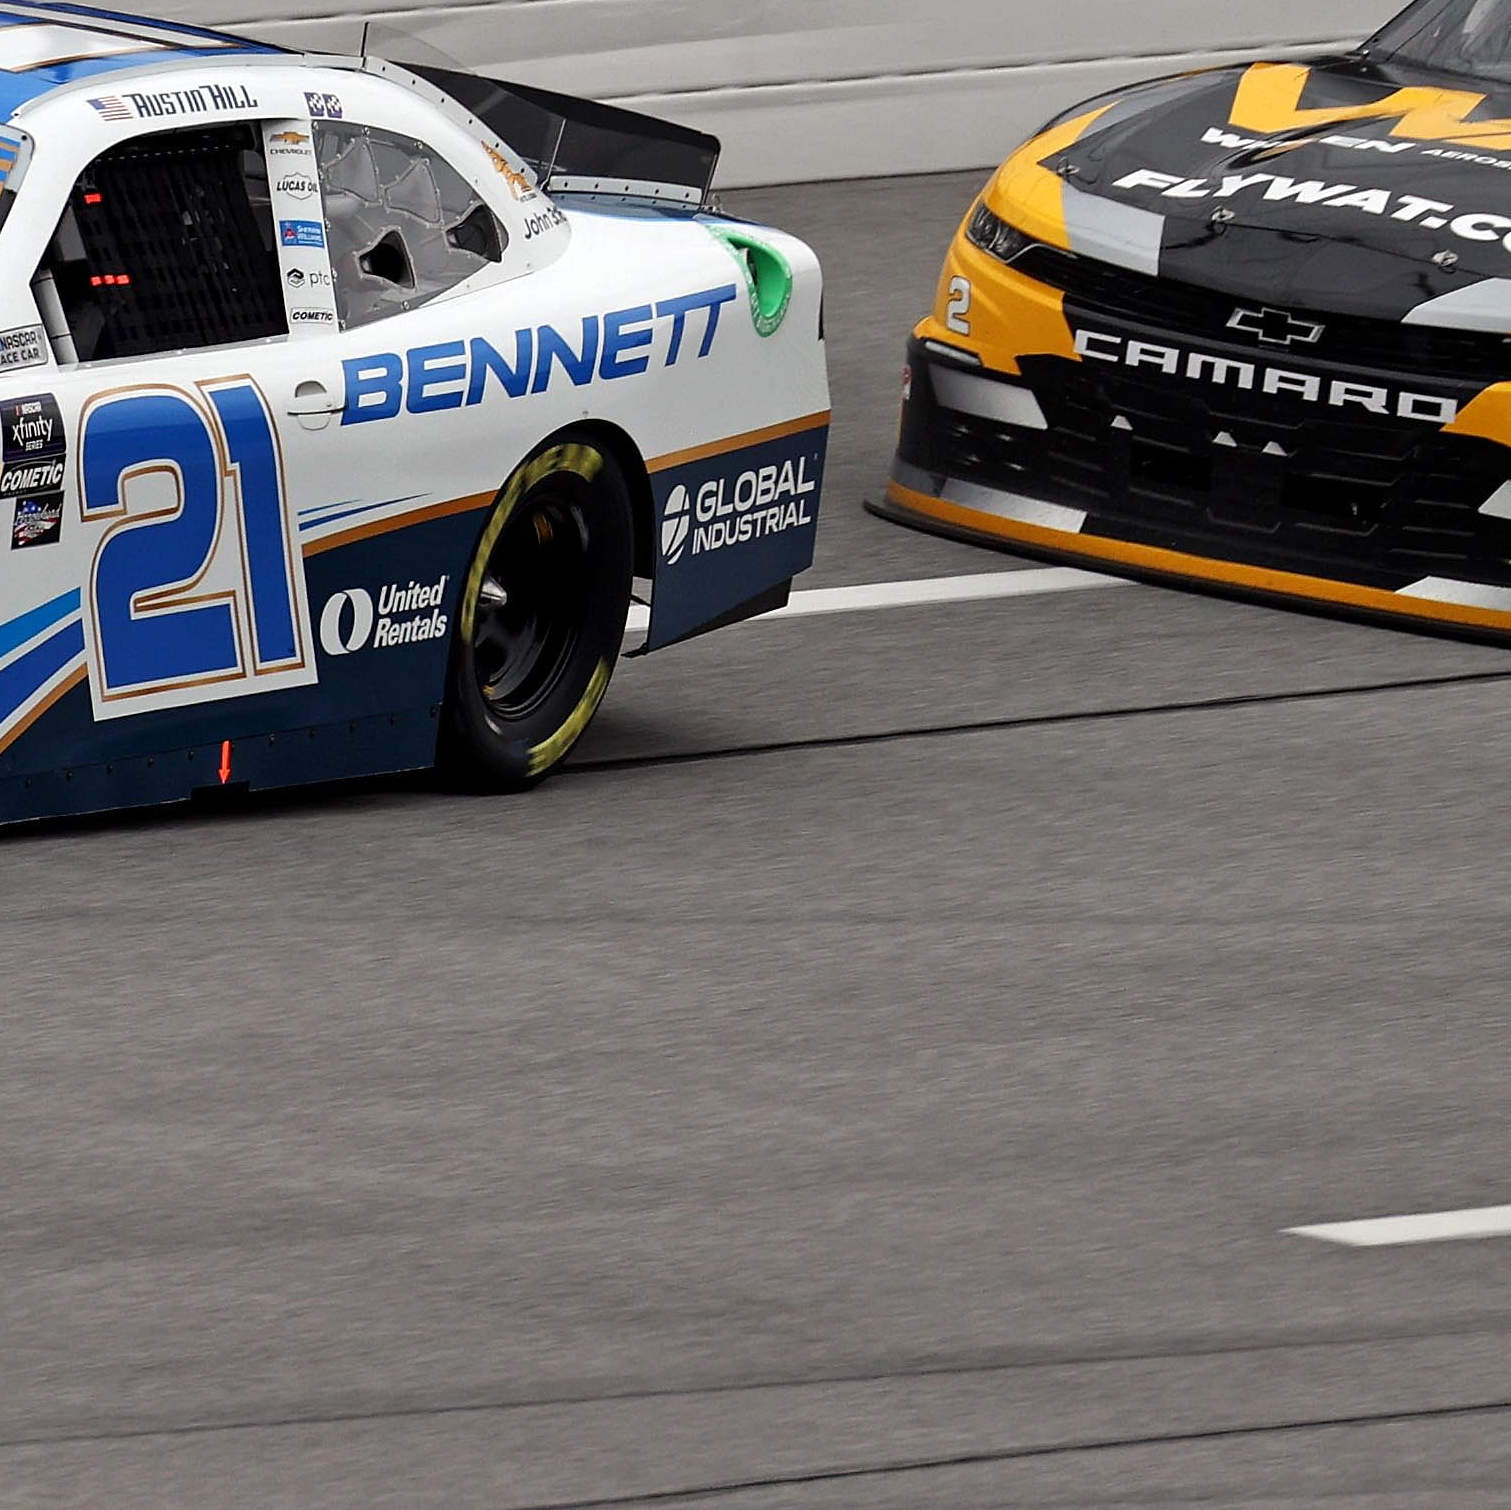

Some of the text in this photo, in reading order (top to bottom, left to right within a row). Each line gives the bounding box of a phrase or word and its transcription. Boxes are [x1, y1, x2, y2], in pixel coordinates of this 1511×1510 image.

[122, 83, 258, 118] AUSTIN HILL
[276, 180, 306, 192] LUCAS
[309, 270, 331, 287] ptc
[292, 311, 333, 321] COMETIC
[945, 275, 971, 337] 2
[20, 348, 41, 361] CAR
[340, 283, 737, 426] BENNETT
[1074, 328, 1459, 424] CAMARO
[12, 415, 54, 447] xfinity
[1, 463, 64, 492] COMETIC
[695, 456, 815, 522] GLOBAL
[76, 372, 305, 702] 21
[691, 499, 812, 555] INDUSTRIAL
[378, 575, 446, 615] United
[373, 608, 448, 648] Rentals
